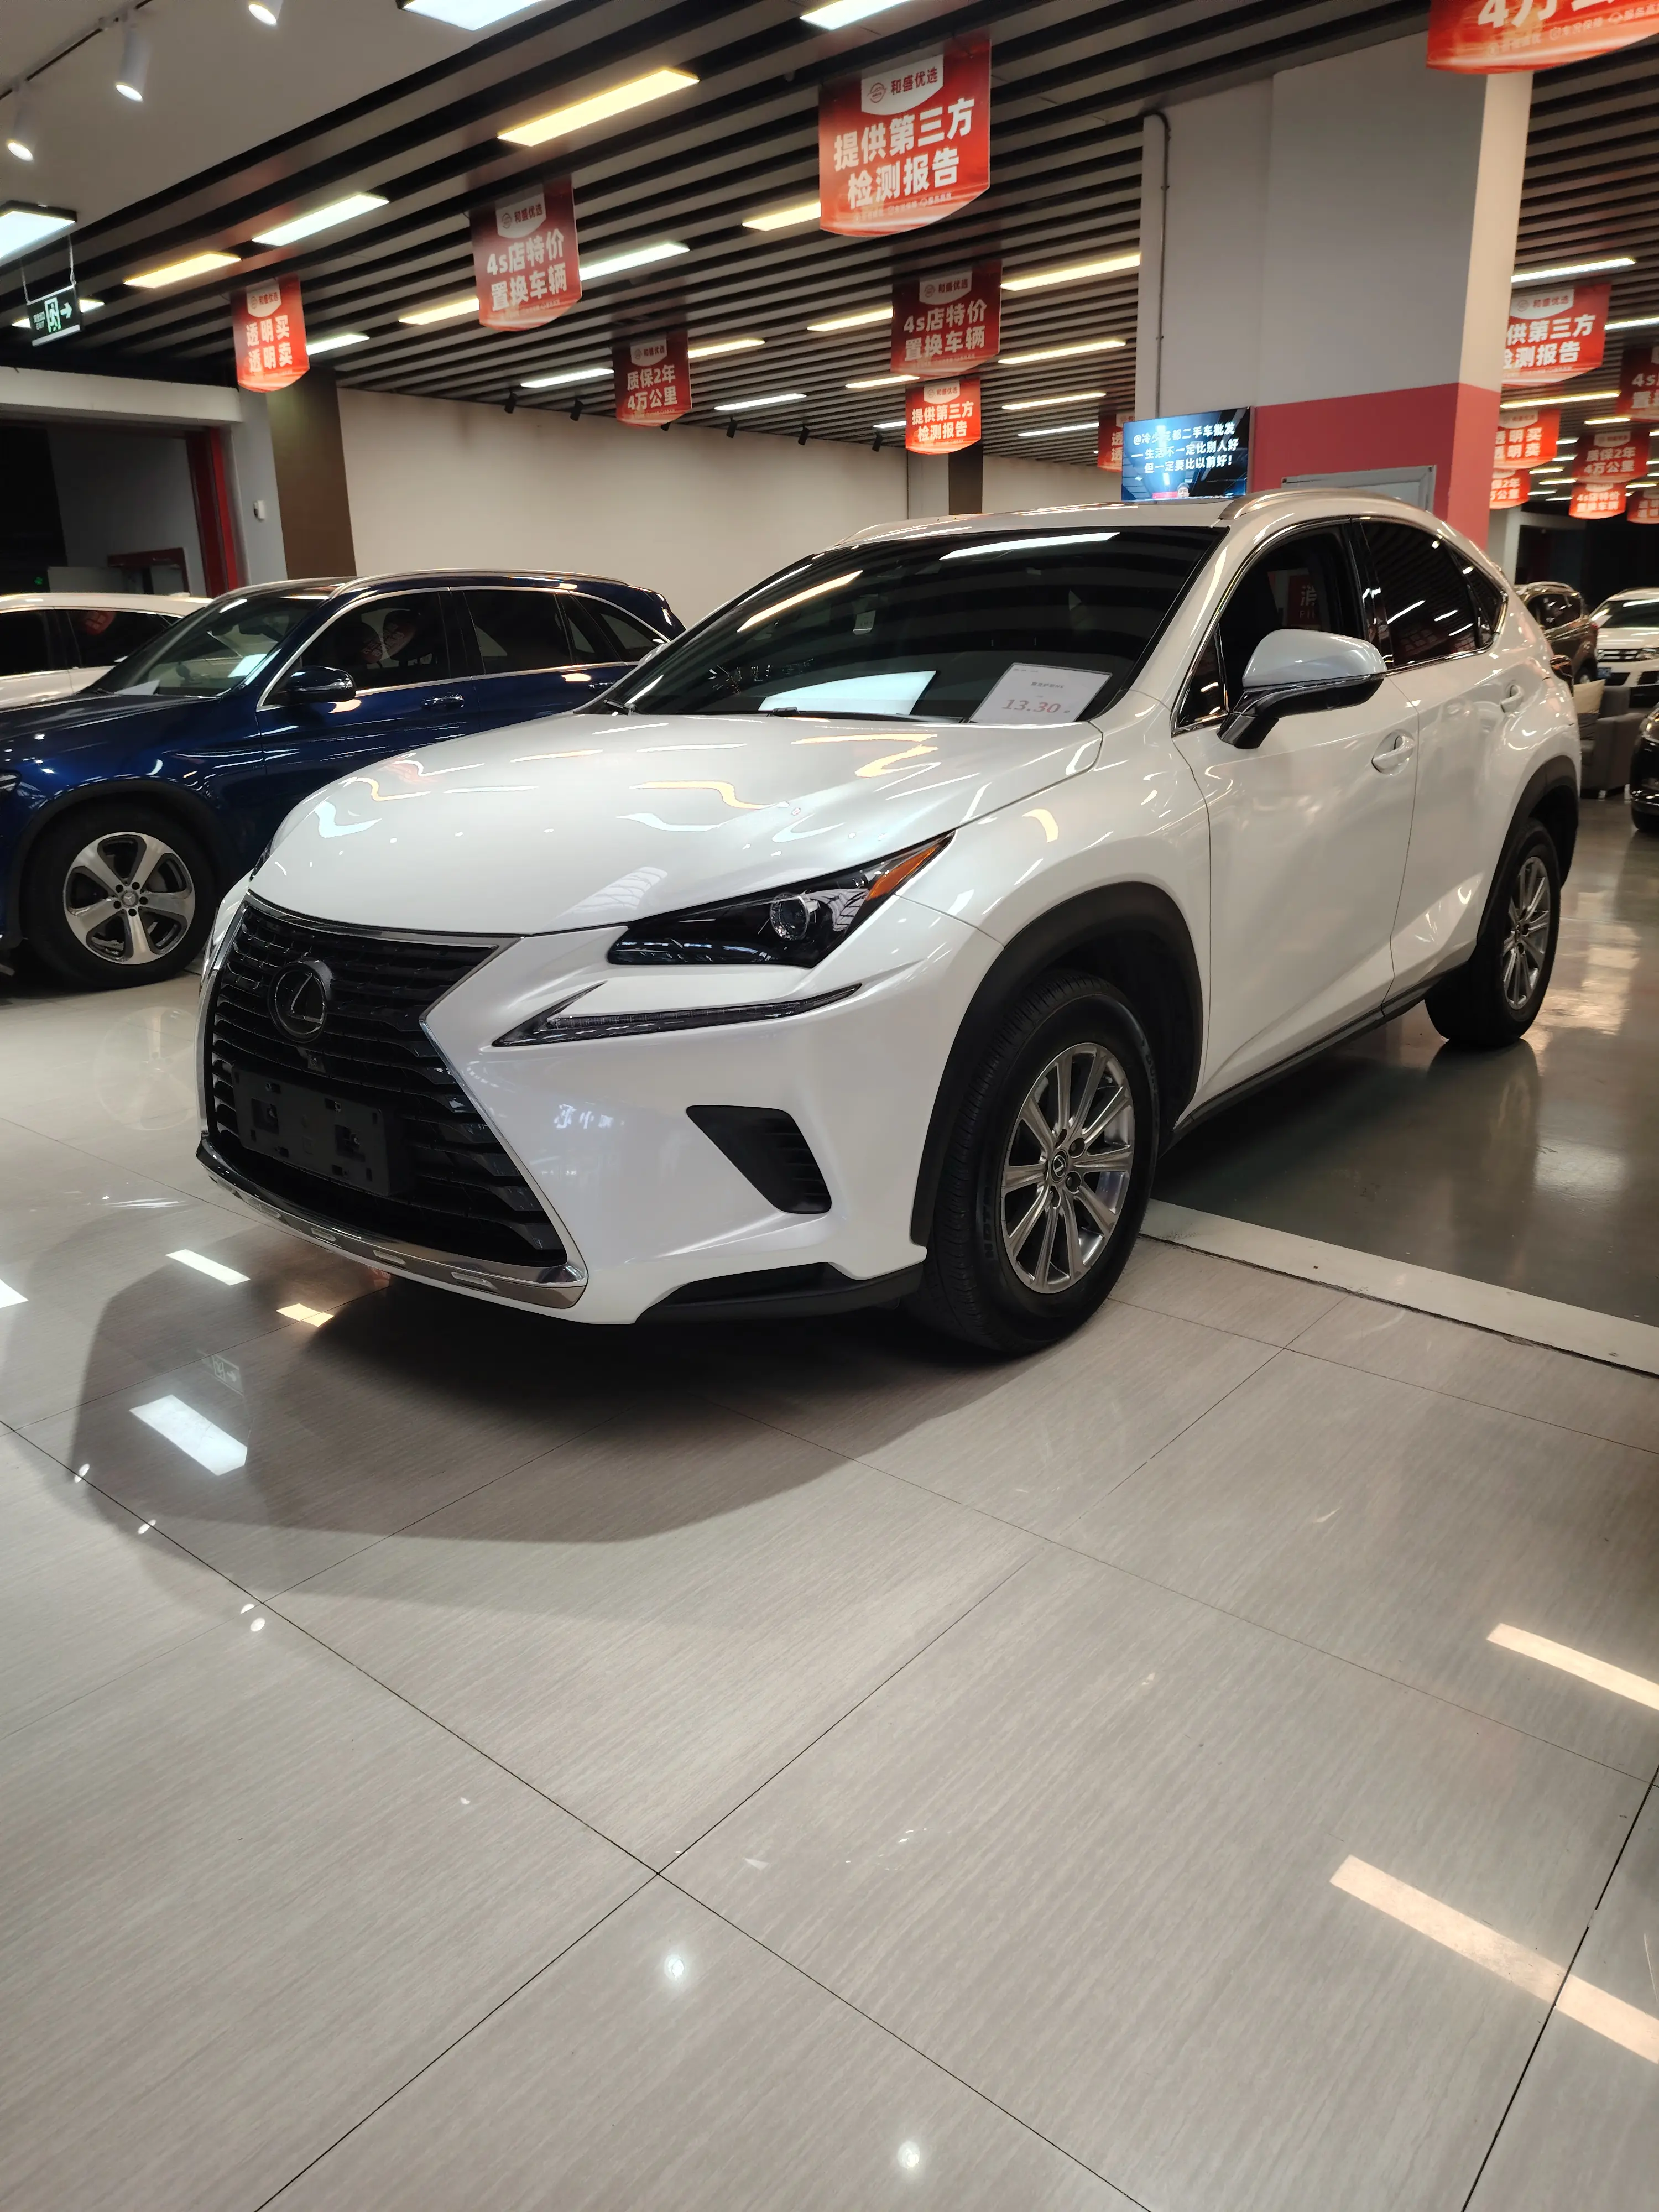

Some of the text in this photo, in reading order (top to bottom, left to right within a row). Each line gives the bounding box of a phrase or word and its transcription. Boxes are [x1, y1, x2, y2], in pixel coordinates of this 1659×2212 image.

[890, 66, 938, 95] 和盛优选
[833, 97, 975, 172] 提供第三方
[847, 147, 960, 210] 检测报告
[487, 228, 565, 276] 4s店特价
[491, 262, 567, 312] 置换车辆
[246, 314, 290, 347] 透明买
[903, 298, 988, 333] 4s店特价
[248, 341, 293, 373] 透明卖
[904, 325, 986, 362] 置换车辆
[627, 364, 676, 392] 质保2年
[627, 385, 678, 411] 4万公里
[911, 400, 974, 426] 提供第三方
[917, 420, 968, 443] 检测报告
